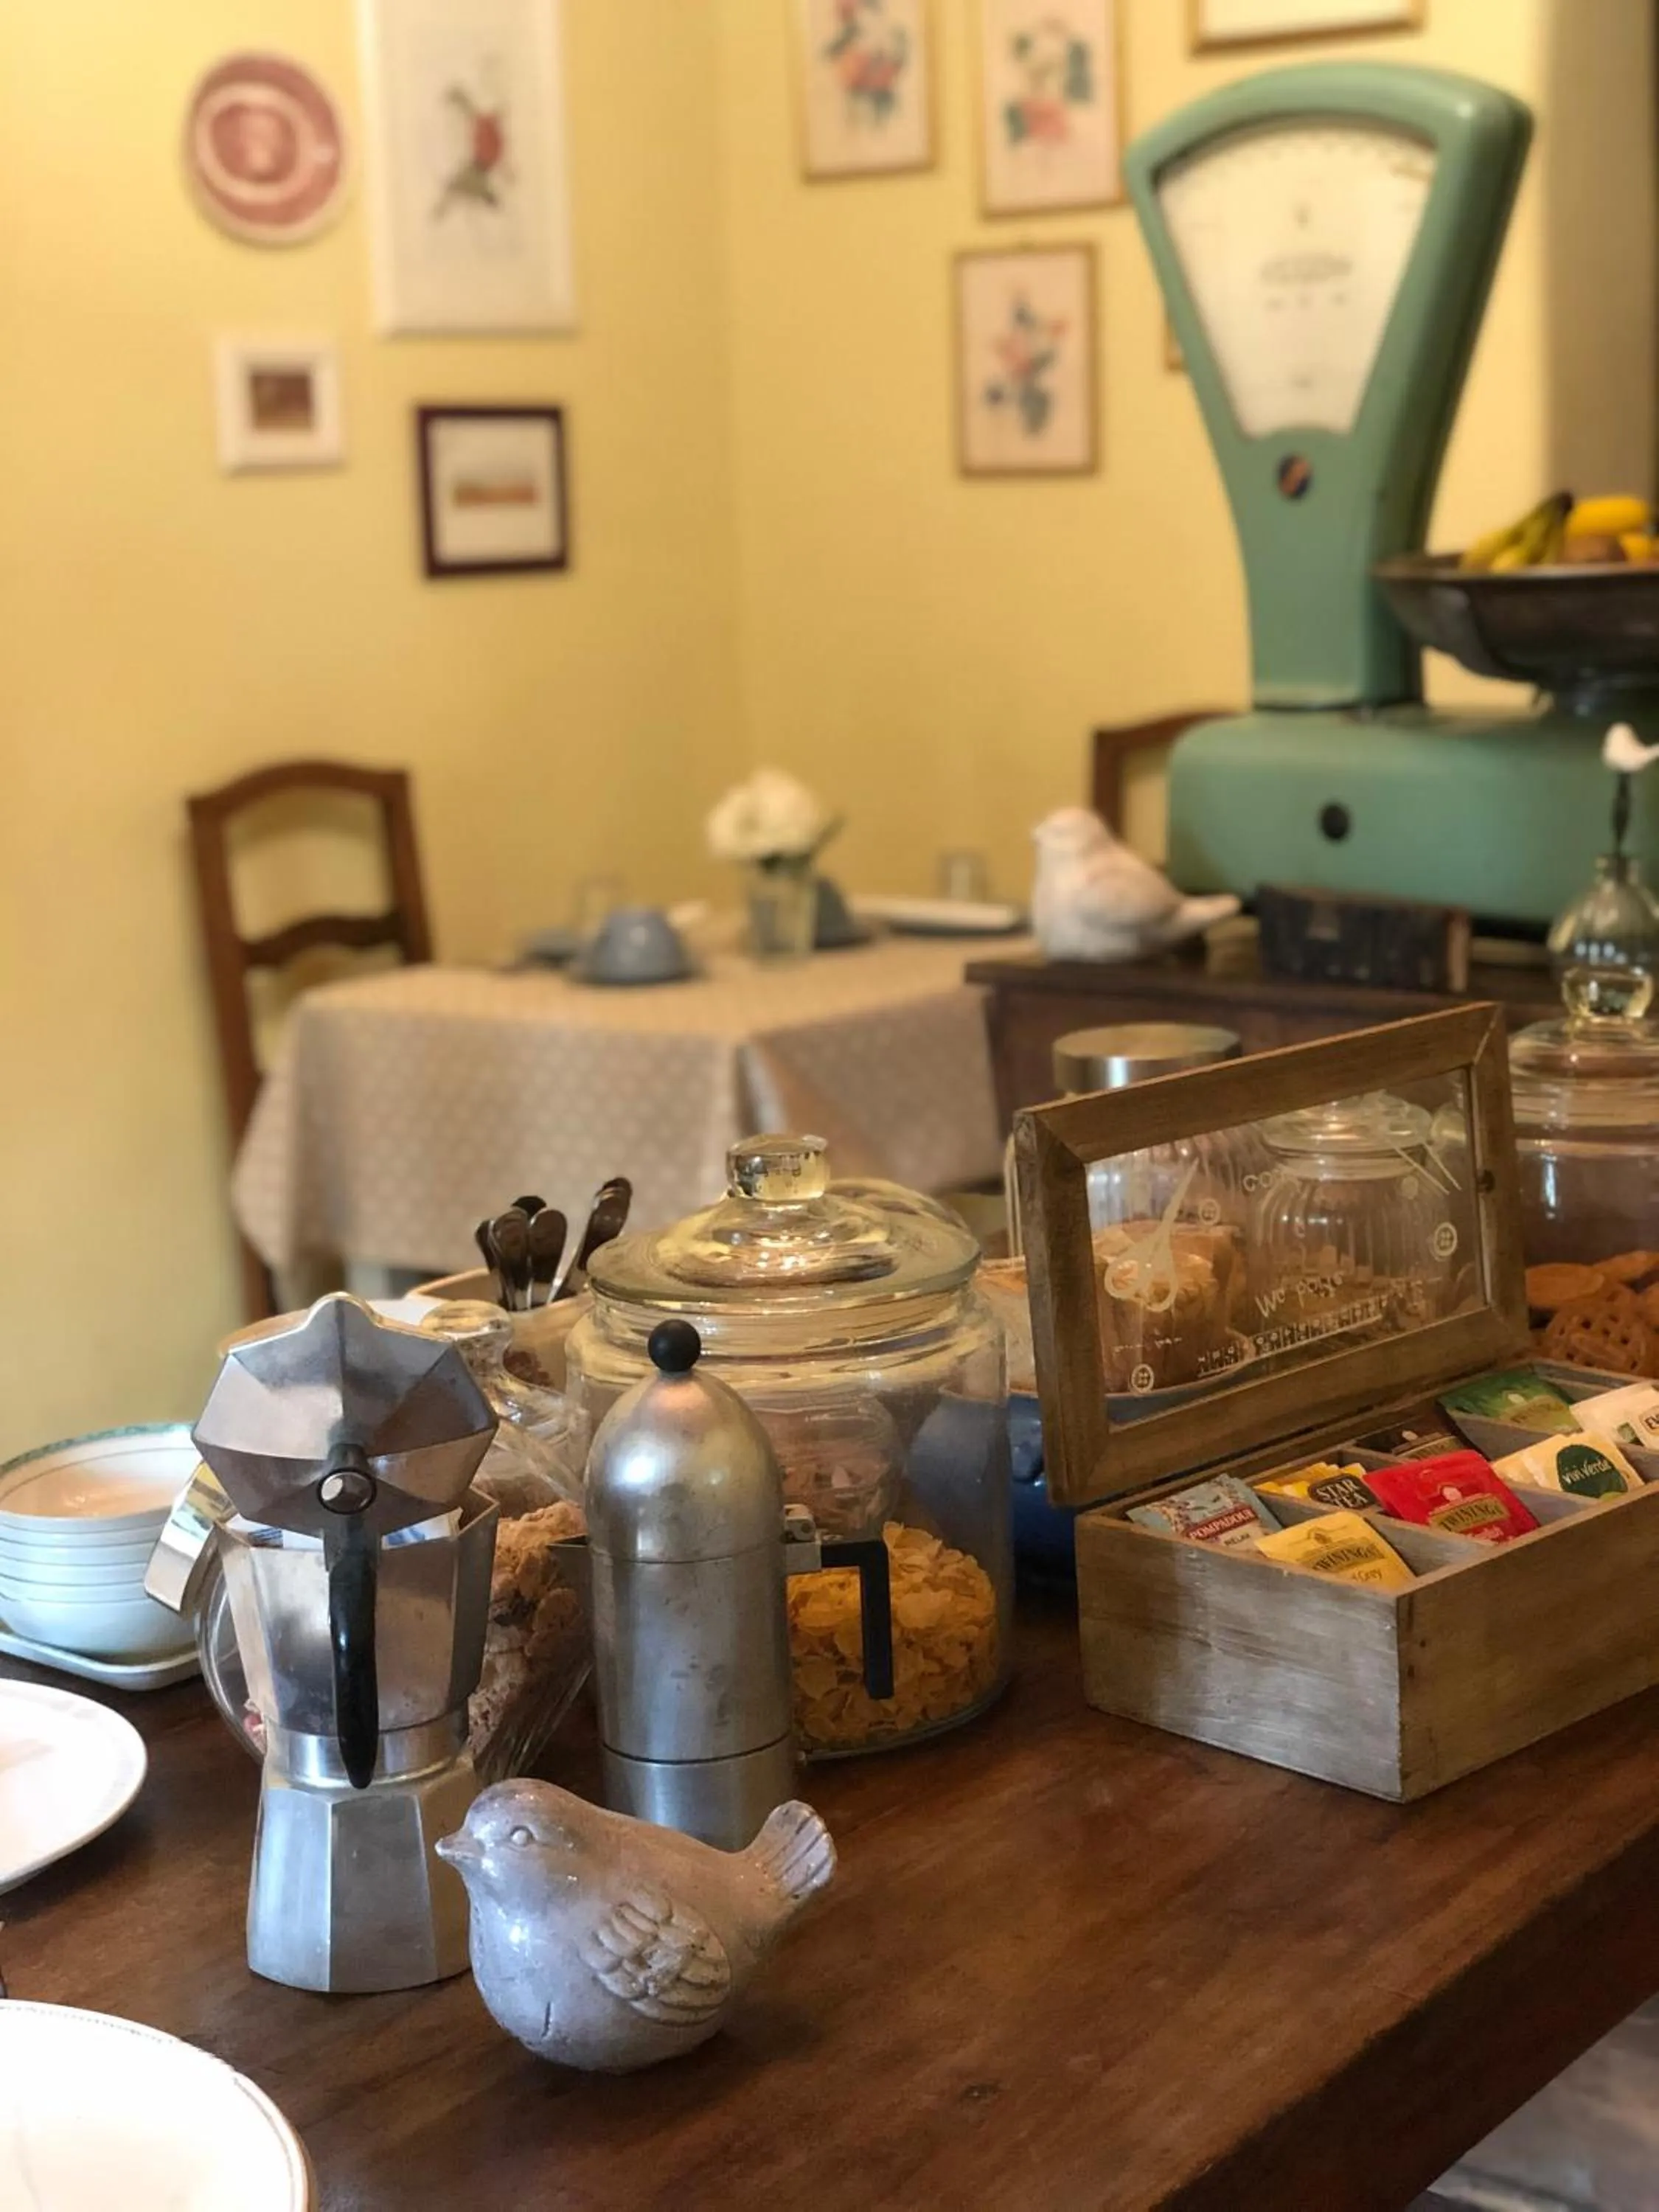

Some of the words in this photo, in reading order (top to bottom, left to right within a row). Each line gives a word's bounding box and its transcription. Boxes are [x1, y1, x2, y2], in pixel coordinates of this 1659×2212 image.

[1315, 1478, 1359, 1503] STAR
[1331, 1492, 1368, 1509] TEA
[1189, 1508, 1255, 1540] POMPADOUR
